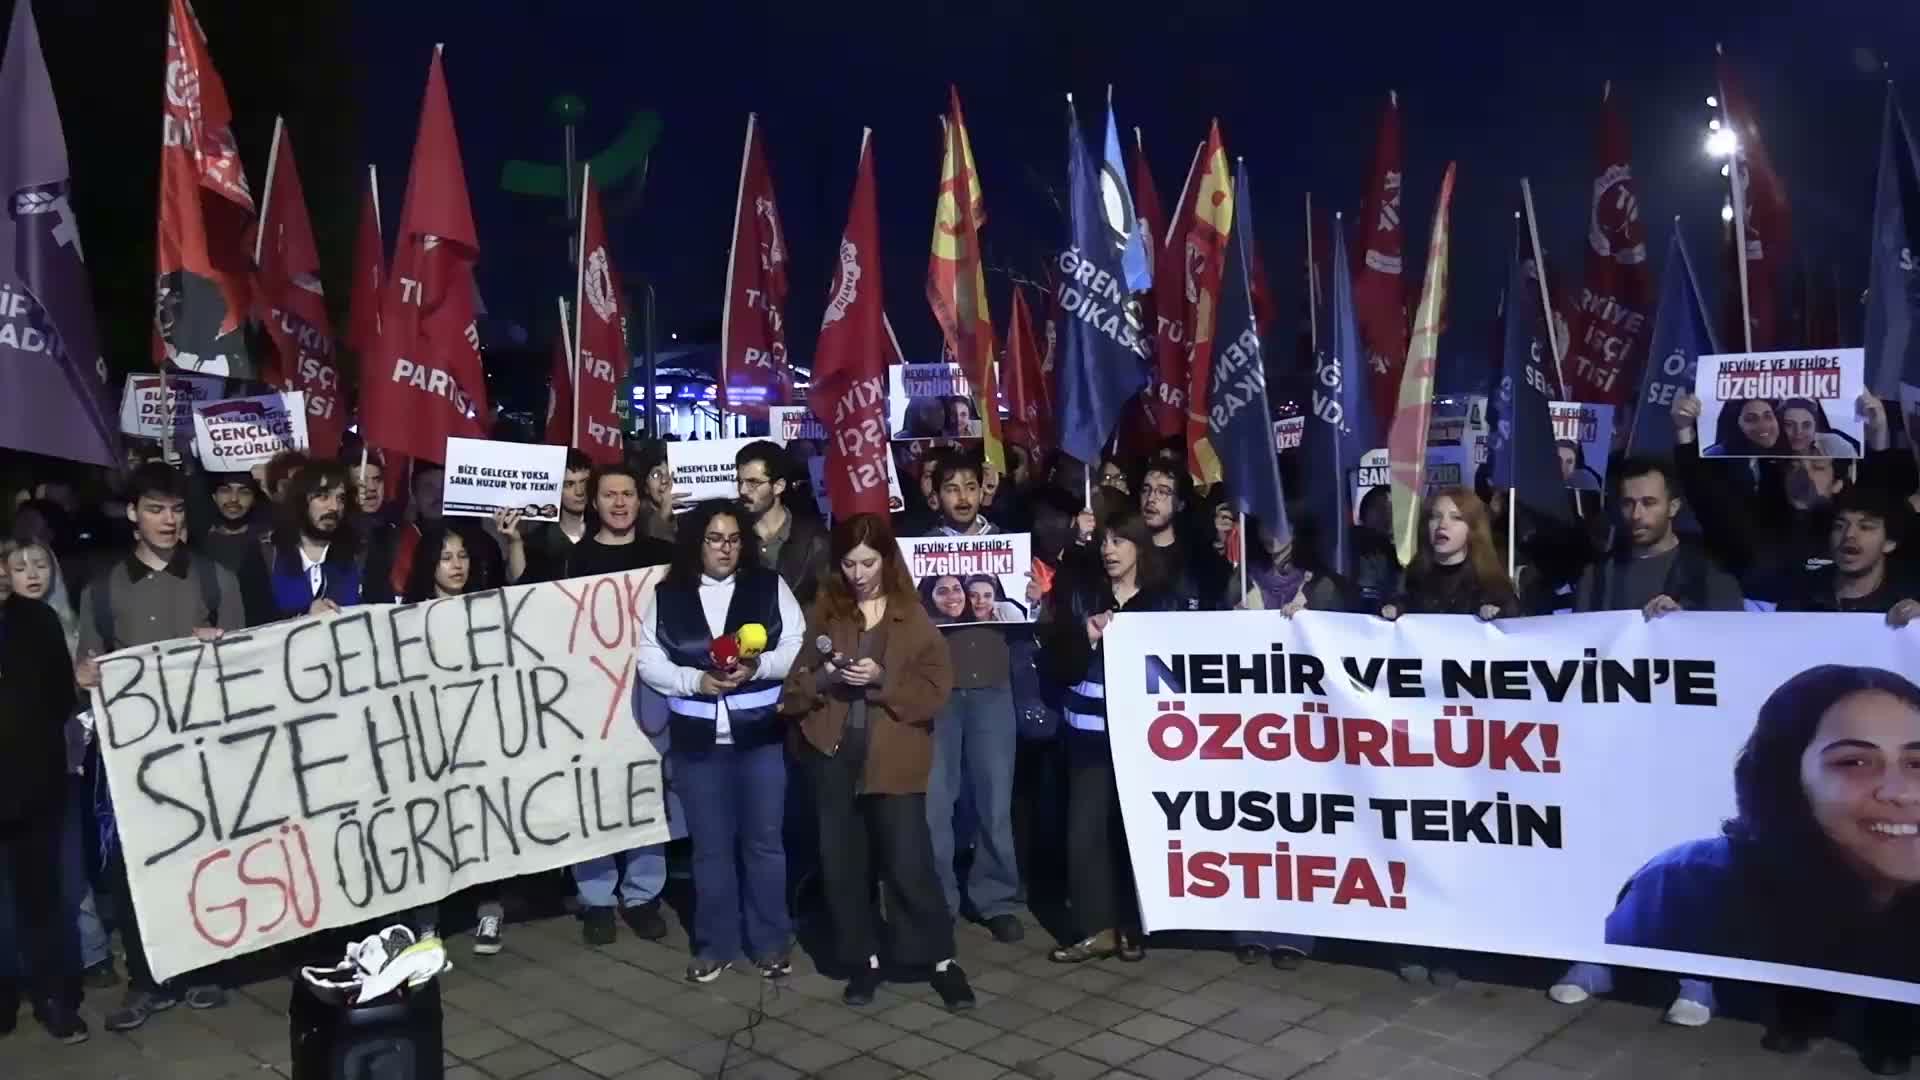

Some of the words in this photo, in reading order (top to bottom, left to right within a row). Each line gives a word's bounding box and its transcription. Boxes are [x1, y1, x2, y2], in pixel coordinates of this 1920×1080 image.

[1157, 315, 1184, 343] TÜ
[1720, 358, 1766, 373] NEVİN'E
[1771, 358, 1785, 369] VE
[1717, 370, 1839, 399] ÖZGÜRLÜK!
[458, 464, 478, 475] BİZE
[481, 467, 518, 479] GELECEK
[521, 470, 549, 480] YOKSA
[673, 476, 694, 484] KATİL
[677, 463, 718, 474] MESEM'LER
[450, 475, 474, 486] SANA
[476, 478, 507, 489] HUZUR
[510, 481, 528, 491] YOK
[530, 482, 558, 492] TEKİN!
[914, 541, 953, 553] NEVİN'E
[957, 541, 970, 552] VE
[972, 540, 1012, 551] NEHİR'E
[914, 552, 1013, 576] ÖZGÜRLÜK!
[98, 634, 276, 749] BİZE
[284, 587, 545, 703] GELECEK
[553, 568, 653, 654] YOK
[1145, 643, 1327, 696] NEHİR
[1341, 656, 1426, 698] VE
[1147, 701, 1561, 773] ÖZGÜRLÜK!
[136, 712, 359, 866] SİZE
[364, 666, 584, 795] HUZUR
[1152, 790, 1355, 835] YUSUF
[1369, 791, 1563, 850] TEKİN
[188, 823, 321, 948] GSÜ
[335, 754, 658, 908] ÖĞRENCİLE
[1167, 839, 1408, 910] İSTİFA!
